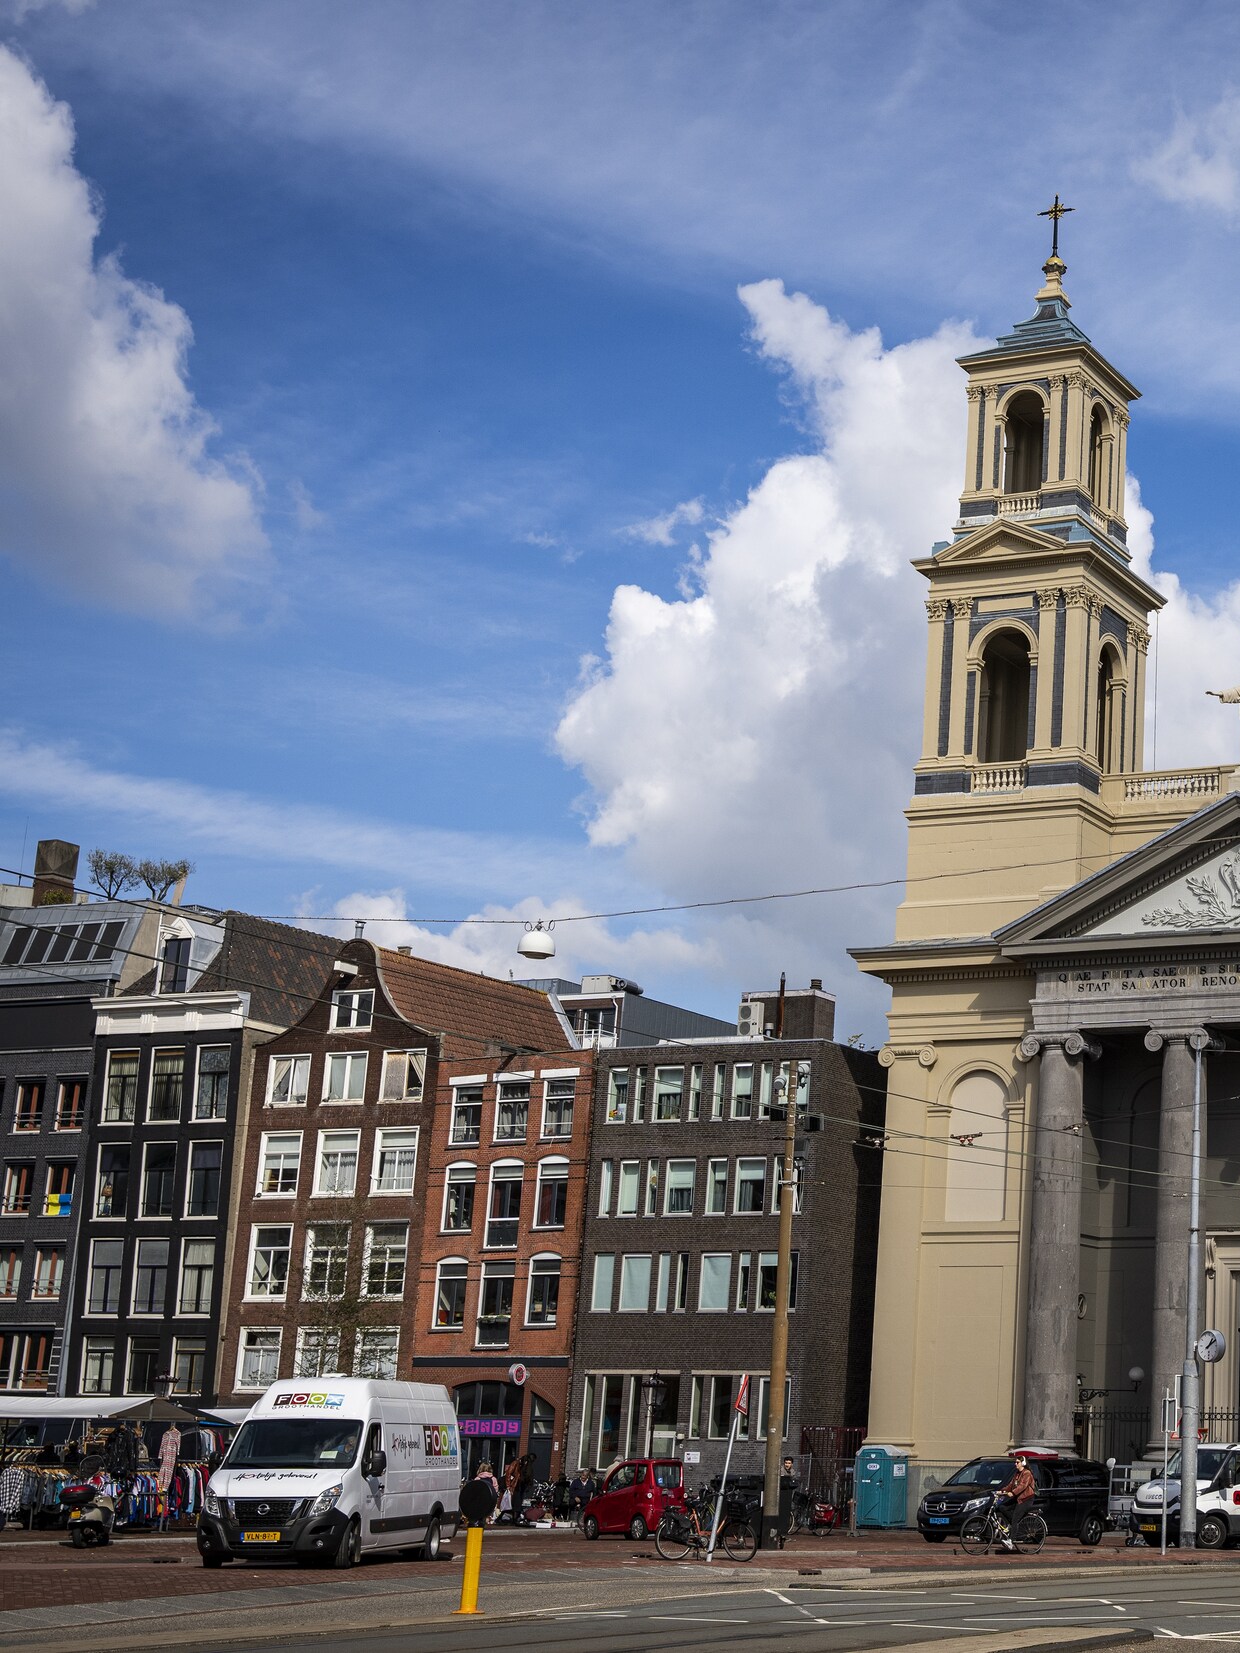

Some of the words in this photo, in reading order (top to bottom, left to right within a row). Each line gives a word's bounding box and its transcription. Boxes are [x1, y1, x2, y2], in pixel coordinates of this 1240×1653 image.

[1058, 971, 1091, 983] QUAE
[1102, 969, 1132, 980] FUIT
[1137, 969, 1145, 979] A
[1153, 966, 1207, 977] SAECLIS
[1077, 982, 1110, 993] STAT
[1121, 978, 1192, 991] SALVATORI
[276, 1394, 343, 1405] FOOX
[424, 1429, 457, 1452] FOOX
